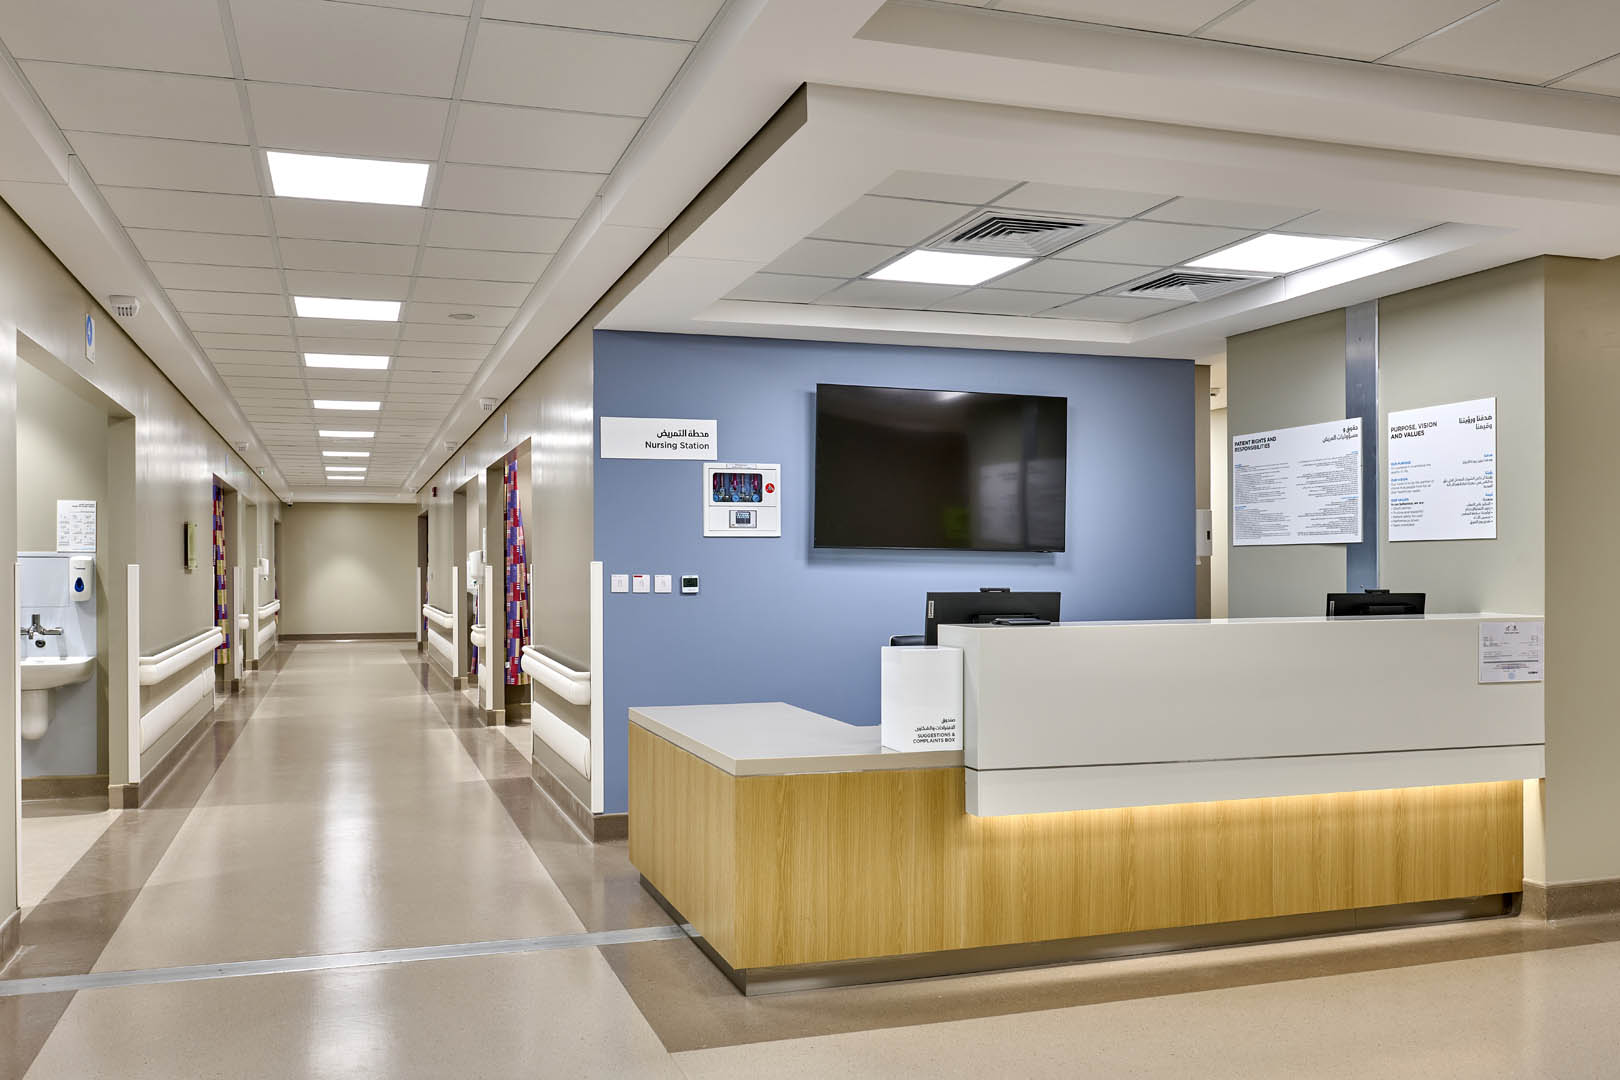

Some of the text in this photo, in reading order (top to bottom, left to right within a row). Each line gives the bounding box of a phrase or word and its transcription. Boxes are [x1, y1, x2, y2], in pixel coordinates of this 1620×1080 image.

[657, 429, 709, 438] محطة التمريض
[645, 441, 710, 450] Nursing Station
[1234, 443, 1270, 452] RESPONSIBILITIES
